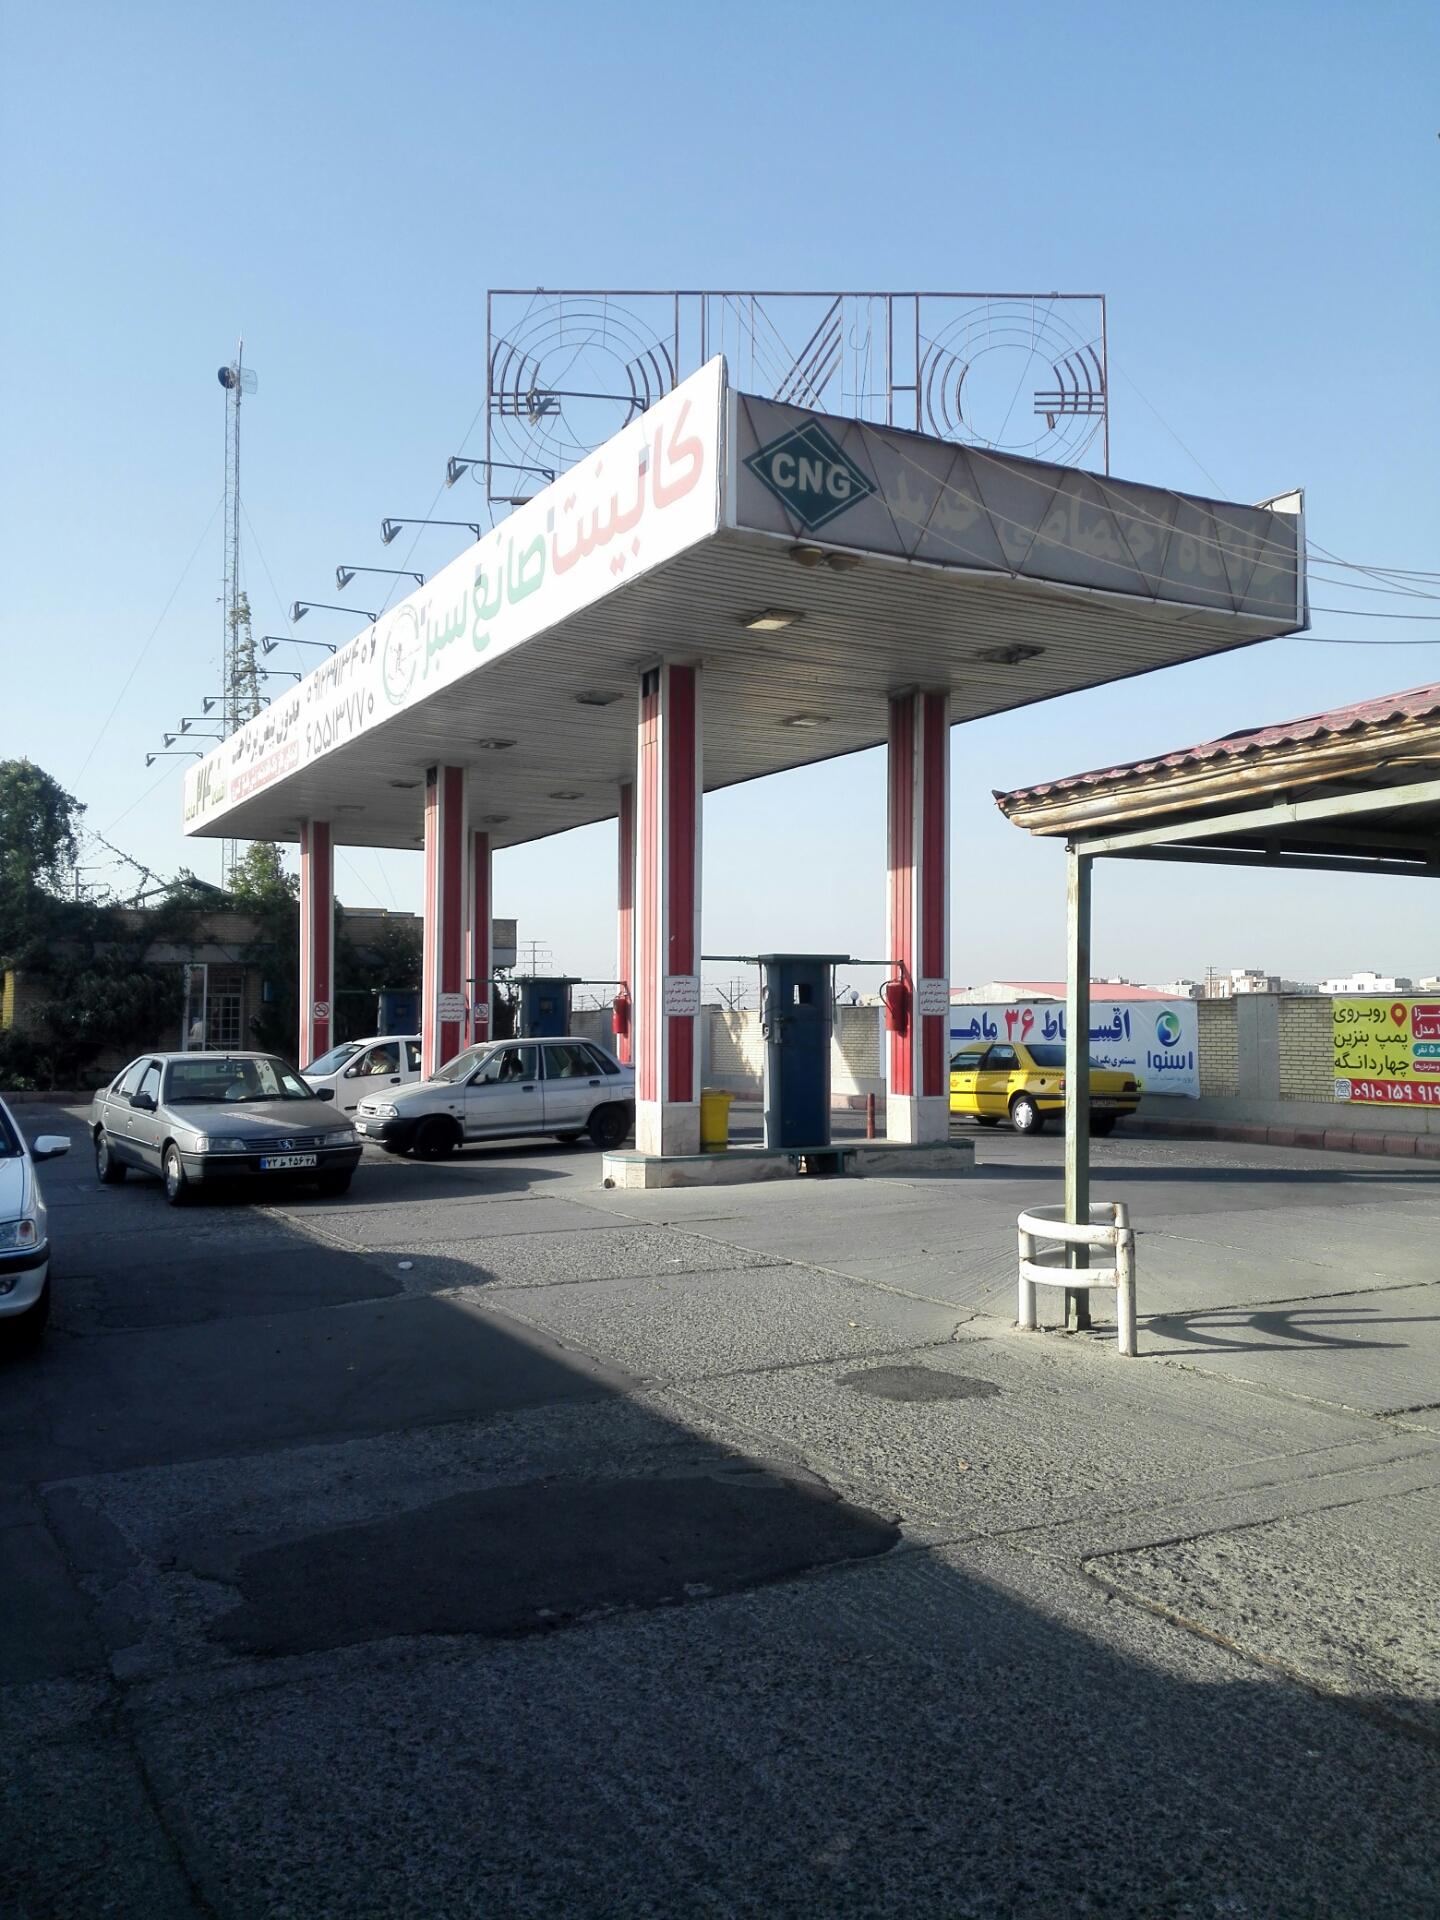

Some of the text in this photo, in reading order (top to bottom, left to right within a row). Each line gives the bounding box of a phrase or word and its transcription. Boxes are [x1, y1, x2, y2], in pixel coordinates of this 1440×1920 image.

[771, 452, 852, 499] CNG
[422, 399, 704, 680] کابینت صانع سبز
[306, 688, 374, 757] ۶۵۵۱۳۷۷۰
[950, 1011, 998, 1040] ماه
[1004, 1008, 1035, 1042] ۳۶
[1333, 1008, 1386, 1023] روبروی
[1334, 1031, 1408, 1050] پمپ بنزین
[1415, 1024, 1435, 1037] مدل
[1147, 1050, 1193, 1072] اسنوا
[1334, 1052, 1409, 1077] چهاردانگه
[1354, 1082, 1383, 1098] ۰۹۱۰
[1387, 1084, 1412, 1100] ۱۵۹
